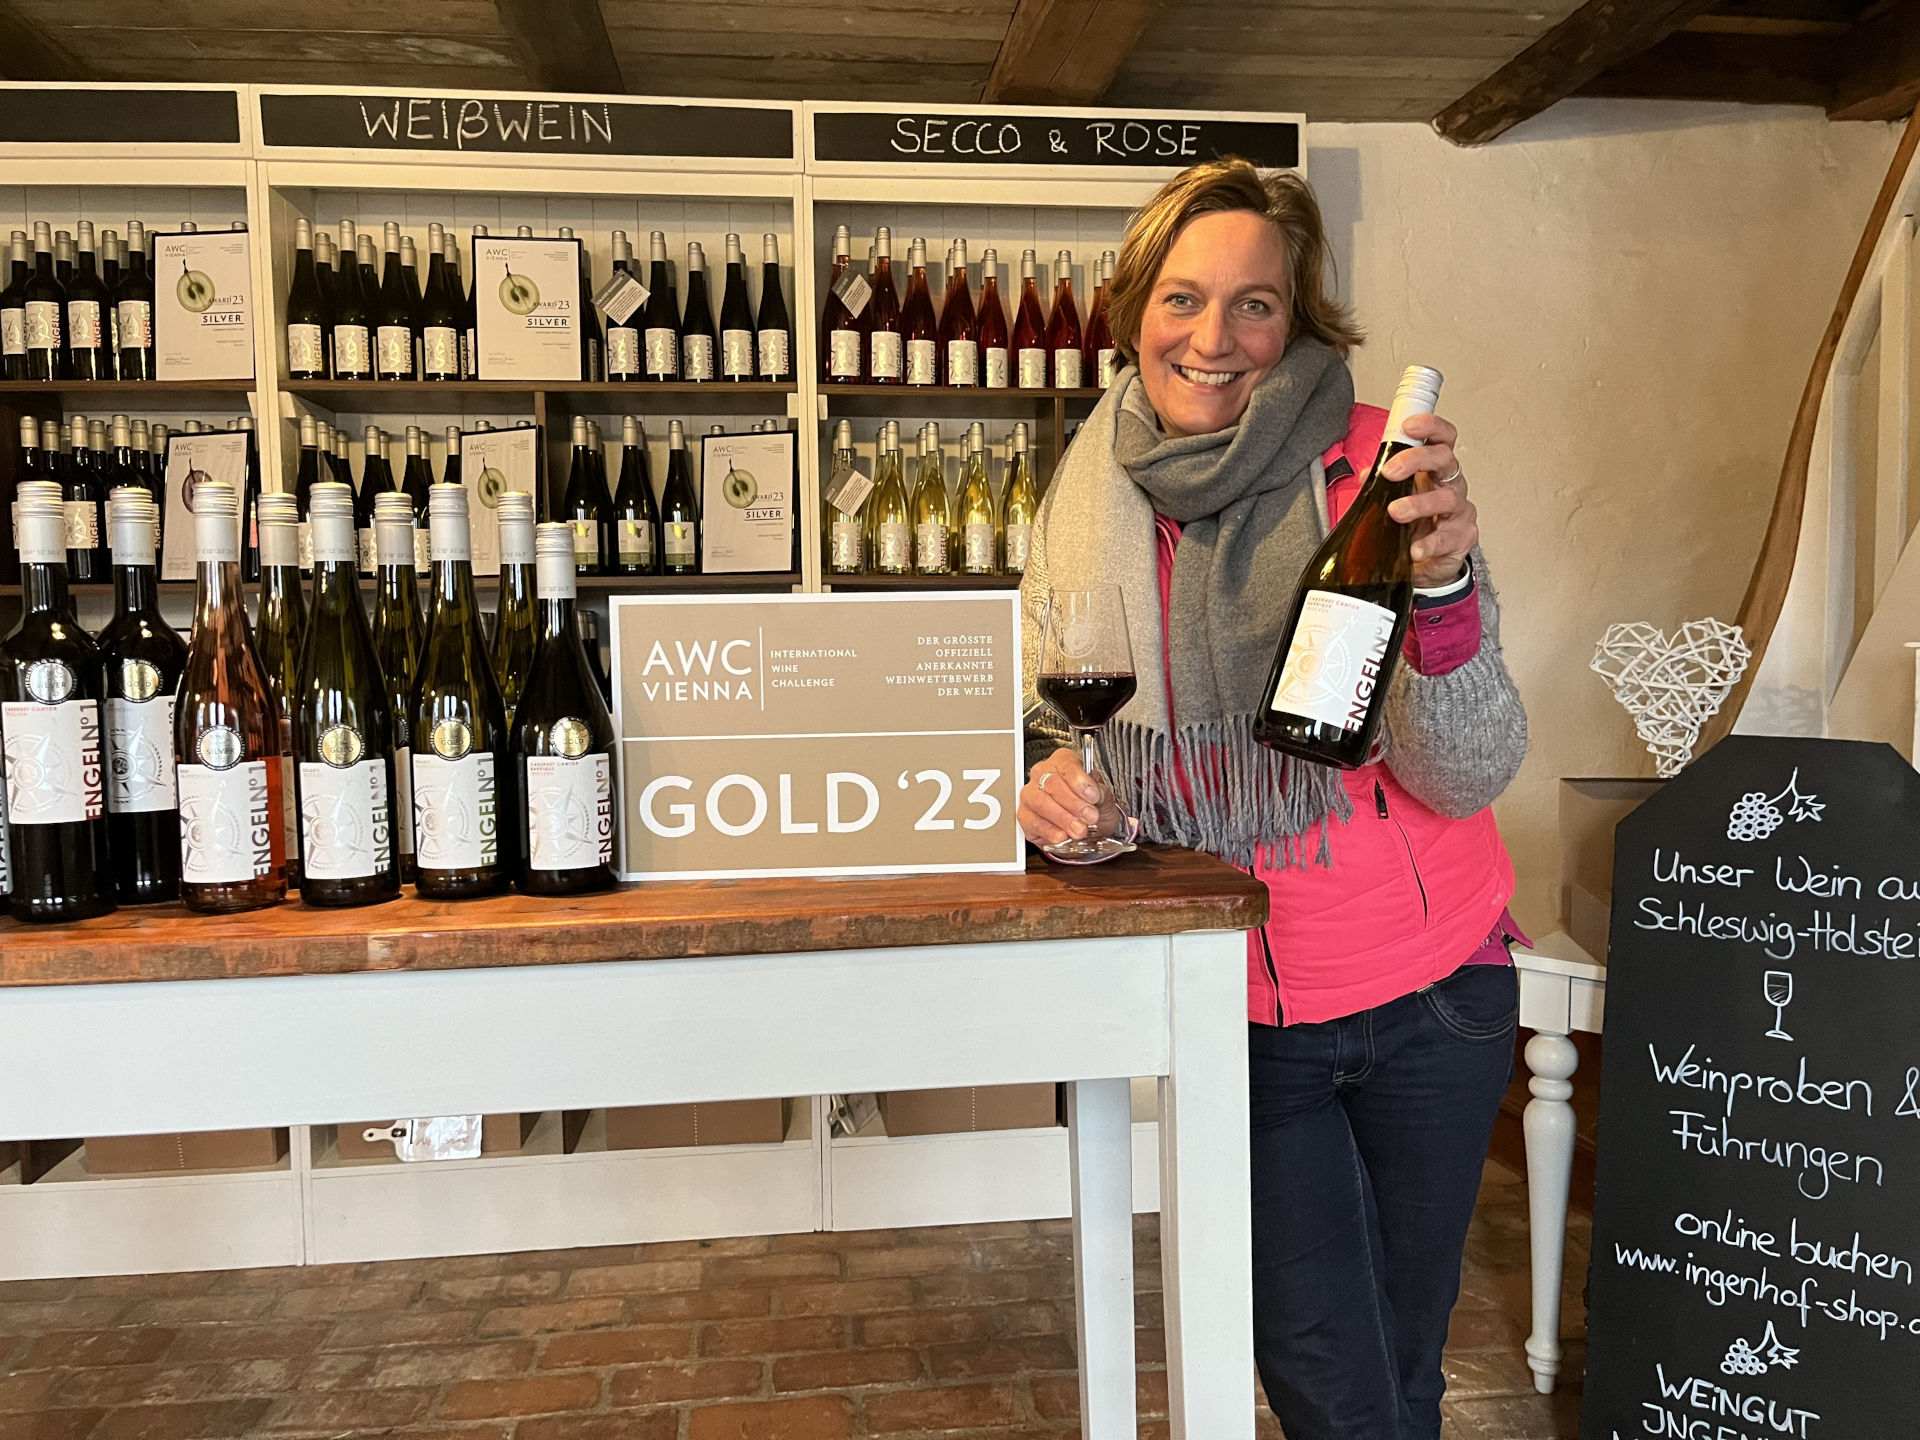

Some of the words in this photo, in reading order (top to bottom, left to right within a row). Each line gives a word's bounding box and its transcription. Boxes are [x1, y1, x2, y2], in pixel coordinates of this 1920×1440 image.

[890, 118, 1021, 153] SECCO
[1049, 129, 1068, 153] &
[1086, 122, 1201, 157] ROSE
[203, 314, 241, 323] SILVER
[527, 318, 567, 326] SILVER
[746, 510, 781, 518] SILVER
[917, 636, 940, 645] DER
[943, 635, 993, 645] GRÖSSTE
[642, 639, 752, 676] AWC
[770, 649, 858, 659] INTERNATIONAL
[935, 648, 993, 658] OFFIZIELL
[771, 664, 799, 673] WINE
[916, 661, 994, 671] ANERKANNTE
[771, 678, 836, 688] CHALLENGE
[885, 674, 994, 684] WEINWETTBEWERB
[642, 681, 753, 702] VIENNA
[937, 688, 961, 696] DER
[964, 687, 994, 696] WELT
[639, 772, 880, 838] GOLD
[1653, 848, 1755, 888] Unser
[1776, 855, 1861, 899] Wein
[1649, 1043, 1872, 1117] Weinproben
[1895, 1066, 1920, 1119] &
[1669, 1110, 1882, 1200] Führungen
[1790, 1218, 1912, 1285] buchen
